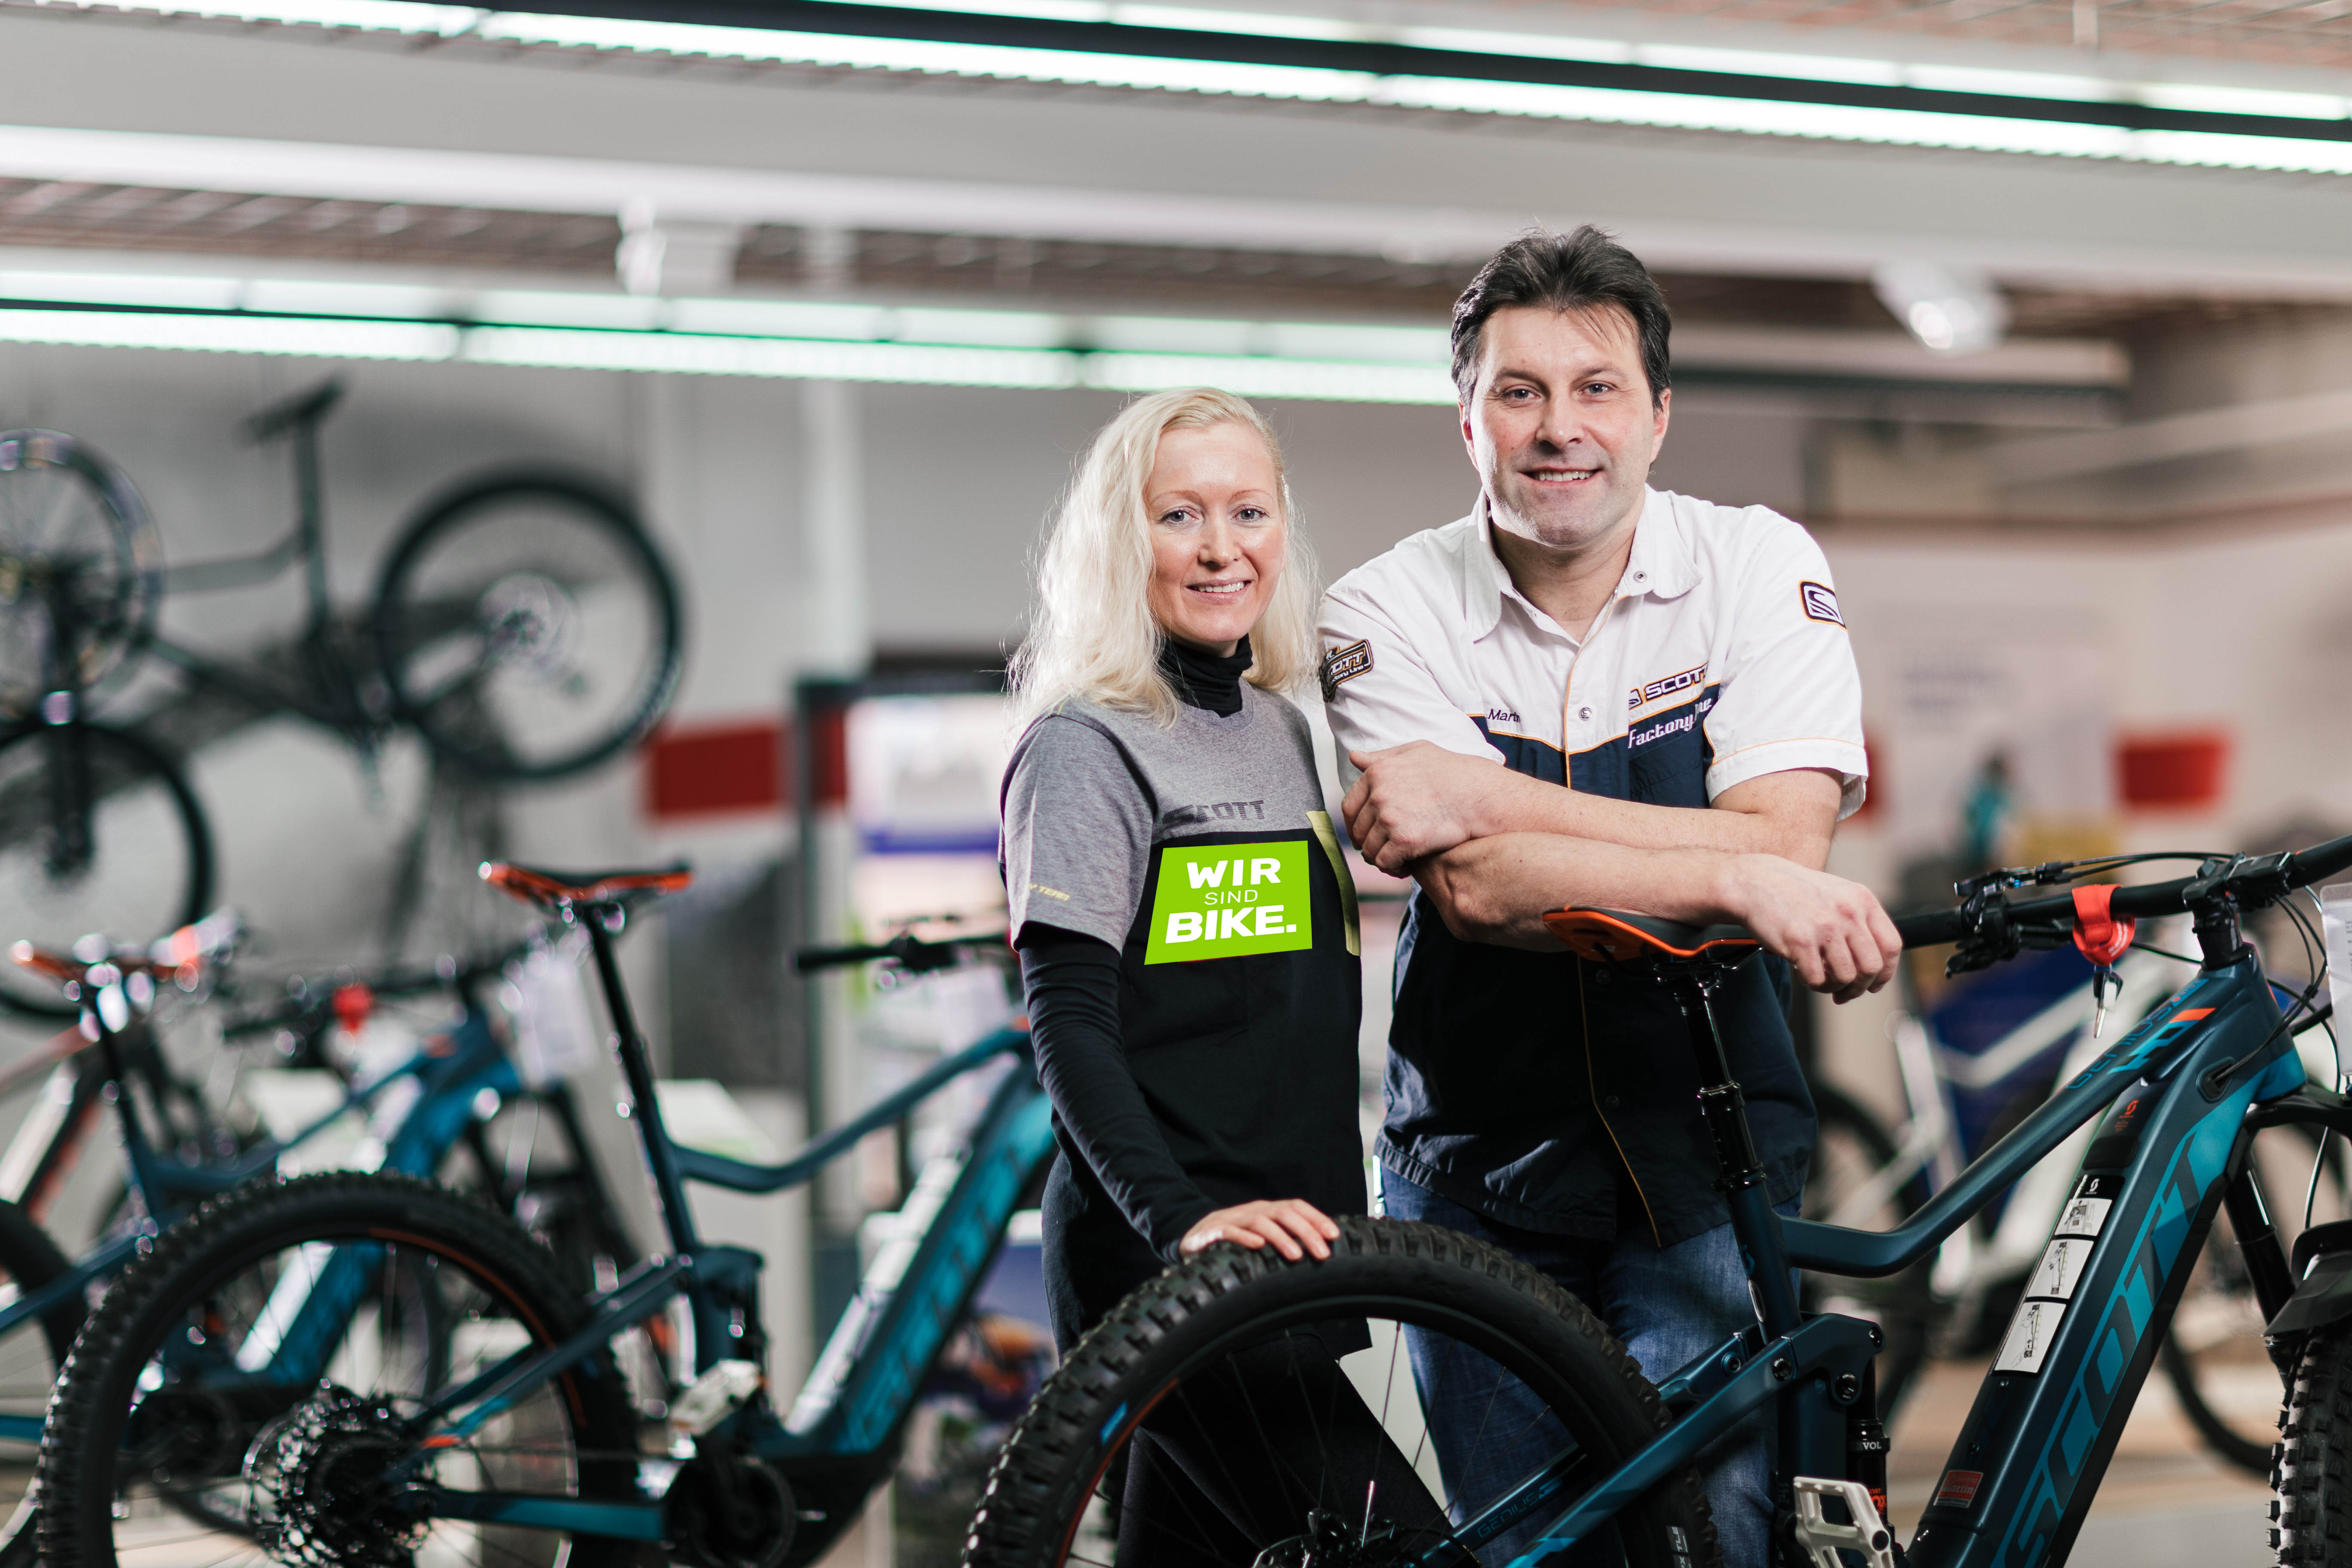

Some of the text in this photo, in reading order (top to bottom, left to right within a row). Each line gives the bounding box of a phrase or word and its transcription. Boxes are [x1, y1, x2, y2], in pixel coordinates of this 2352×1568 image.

[1628, 714, 1696, 749] Factory
[1162, 800, 1265, 830] SCOTT
[1187, 858, 1281, 889] WIR
[1204, 889, 1258, 905] SIND
[1165, 904, 1297, 944] BIKE.
[2004, 1130, 2201, 1568] SCOTT
